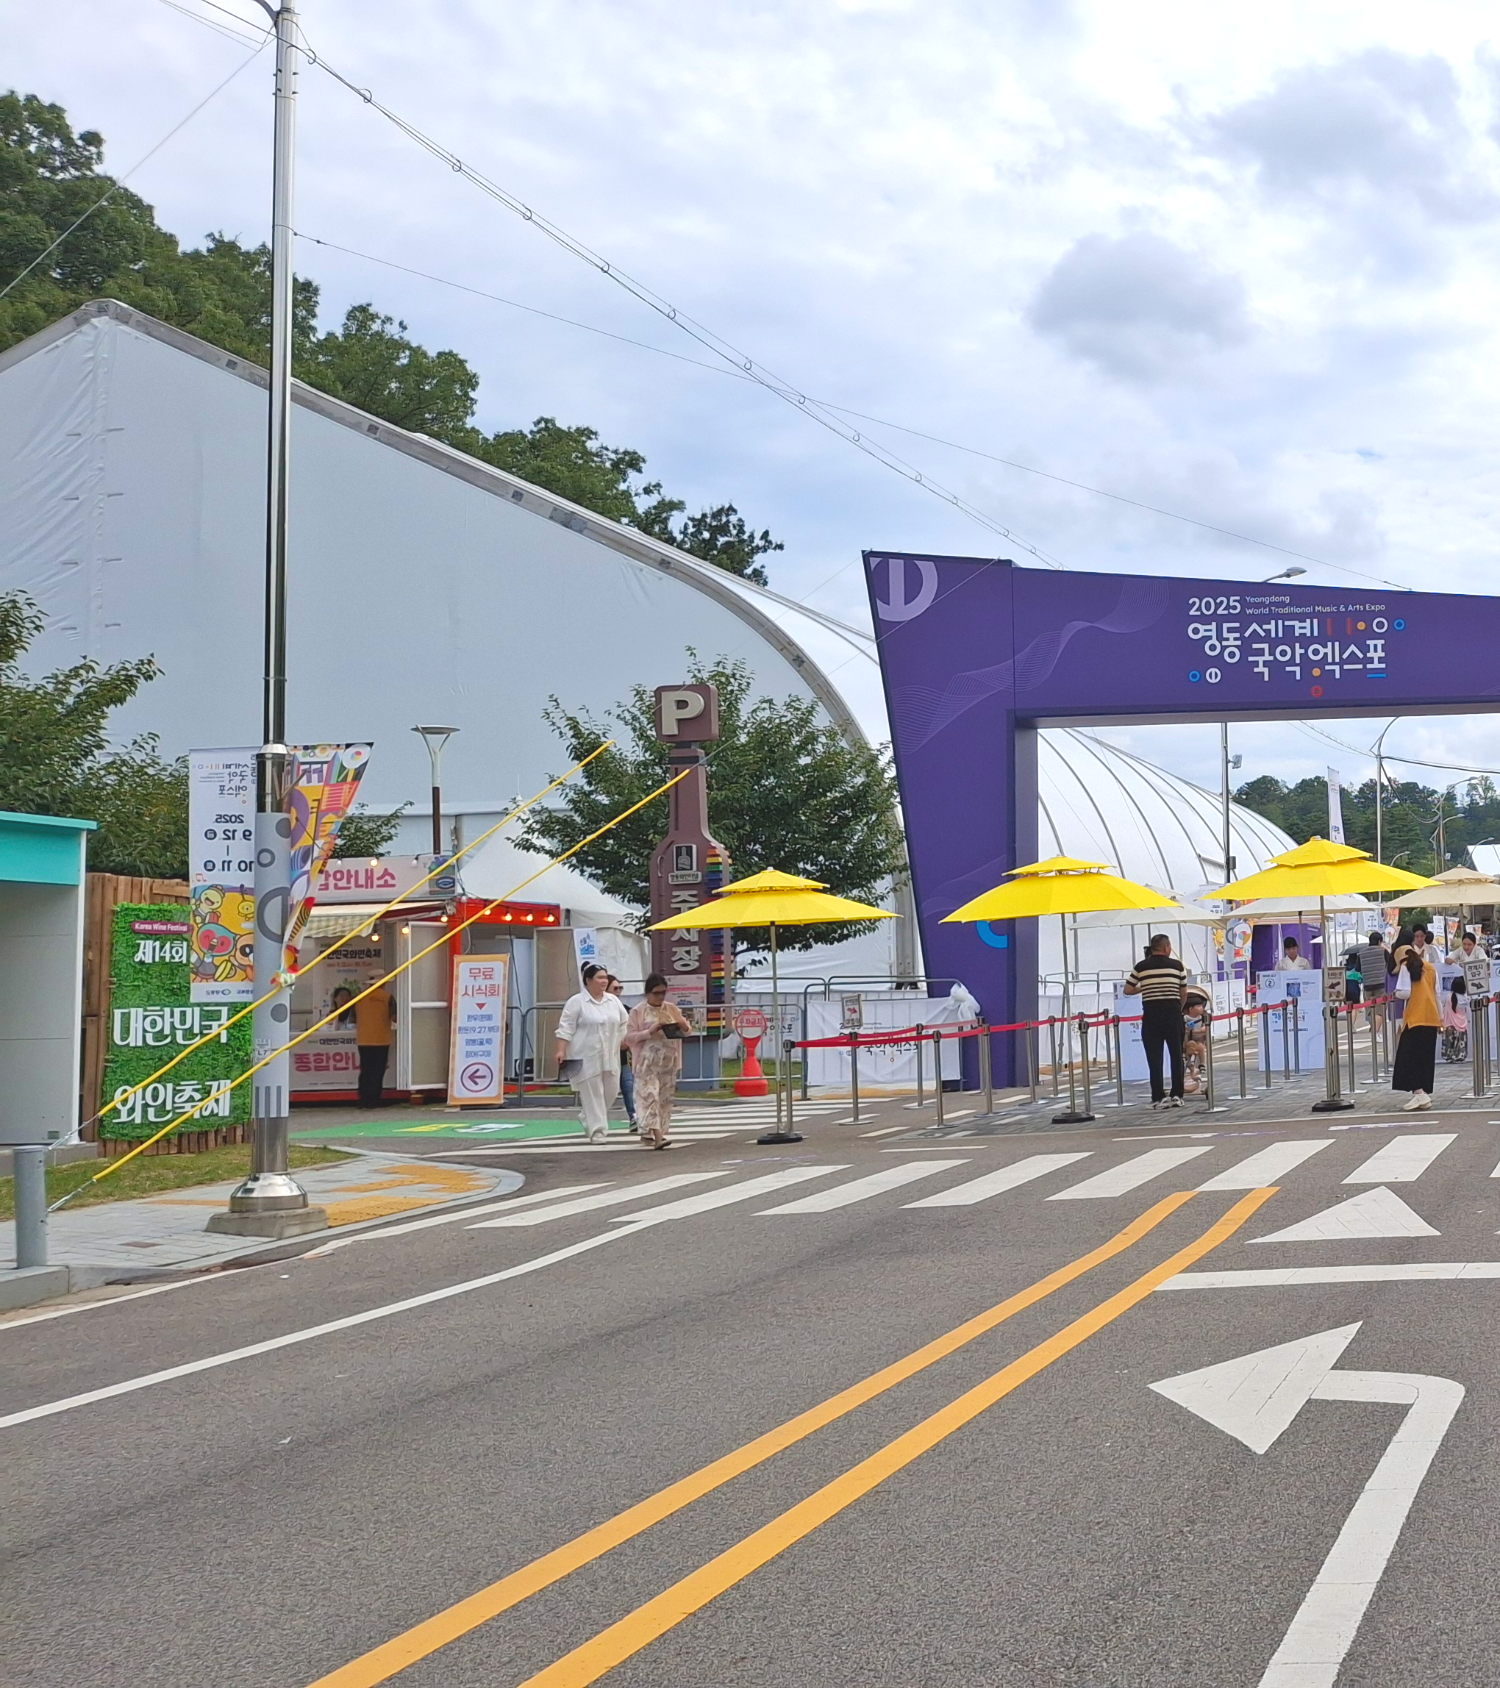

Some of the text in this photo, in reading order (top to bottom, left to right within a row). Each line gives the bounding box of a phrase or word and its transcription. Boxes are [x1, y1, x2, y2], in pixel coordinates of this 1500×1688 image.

[1188, 596, 1241, 616] 2025
[1246, 594, 1290, 604] Yeongdong
[1246, 606, 1269, 615] World
[1271, 605, 1313, 614] Traditional
[1315, 604, 1337, 613] Music
[1347, 603, 1364, 612] Arts
[1366, 603, 1386, 612] Expo
[1188, 618, 1319, 664] 영동세계
[1248, 639, 1386, 682] 국악엑스포
[661, 690, 705, 736] P
[168, 923, 188, 931] Festival
[134, 940, 187, 964] 제14회
[468, 967, 494, 981] 무료
[461, 984, 500, 998] 시식회
[113, 1006, 229, 1047] 대한민국
[112, 1079, 231, 1125] 와인축제
